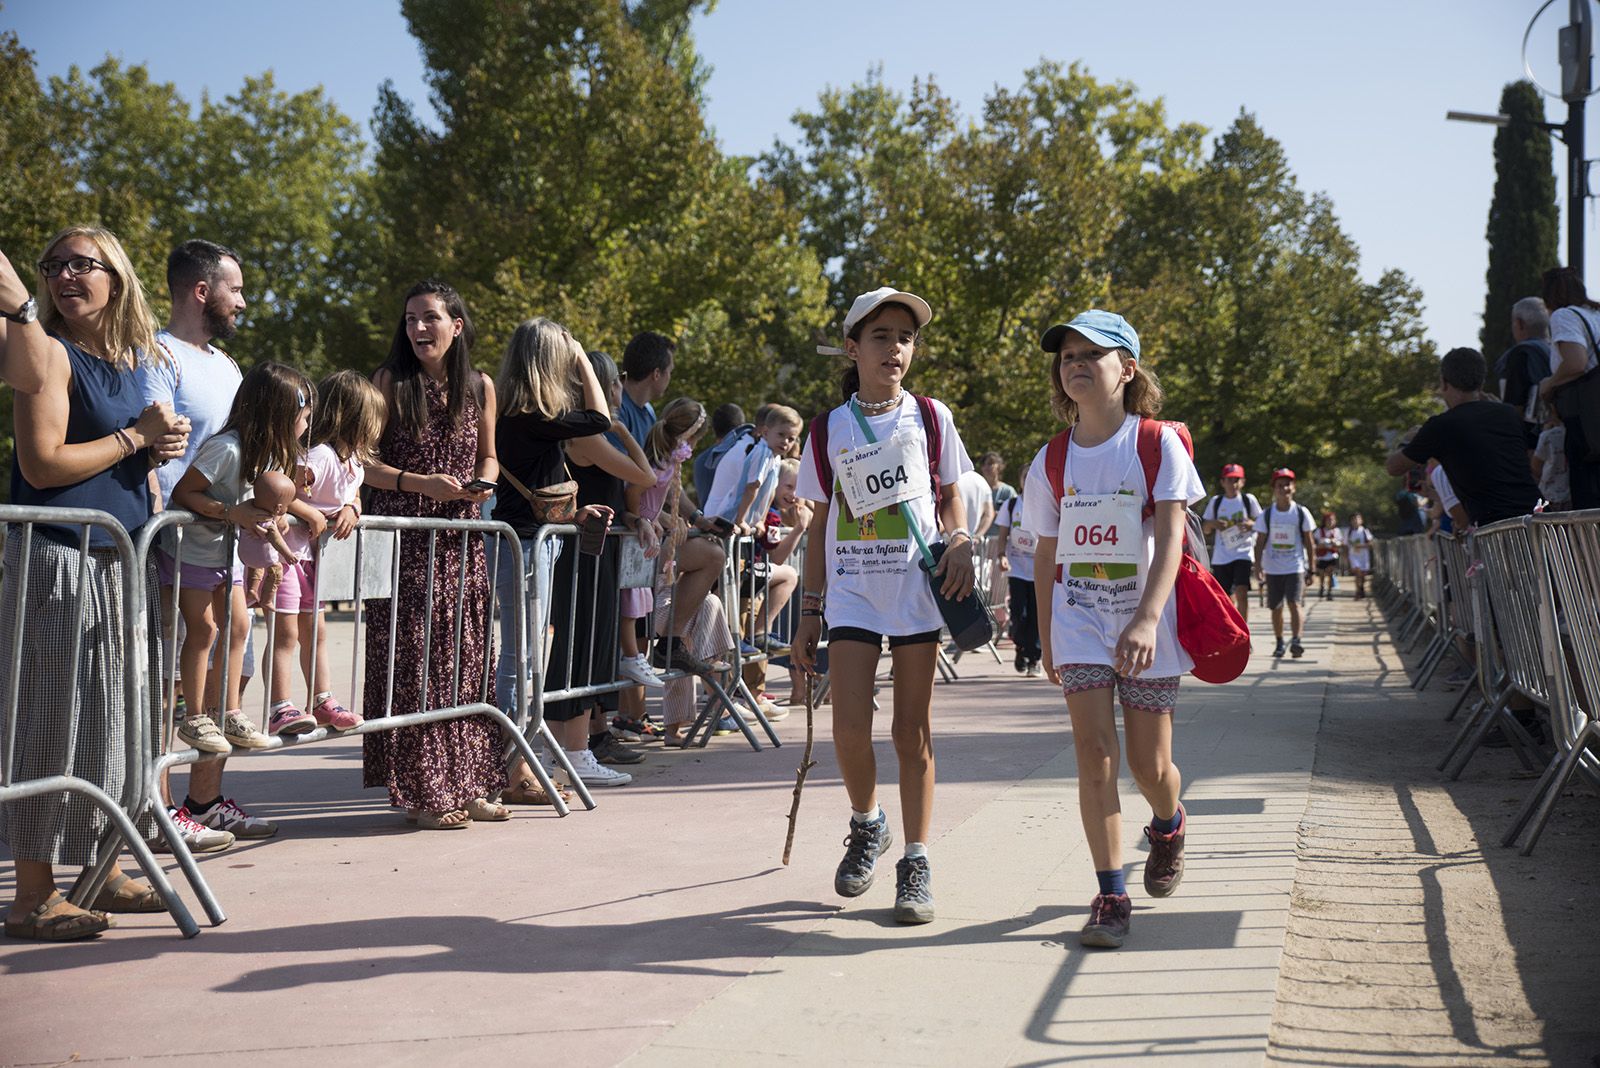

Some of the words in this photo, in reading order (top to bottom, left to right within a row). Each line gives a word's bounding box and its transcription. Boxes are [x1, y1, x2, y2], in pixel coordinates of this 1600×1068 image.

[866, 465, 908, 494] 064
[1074, 524, 1119, 546] 064
[875, 544, 909, 557] Infantil
